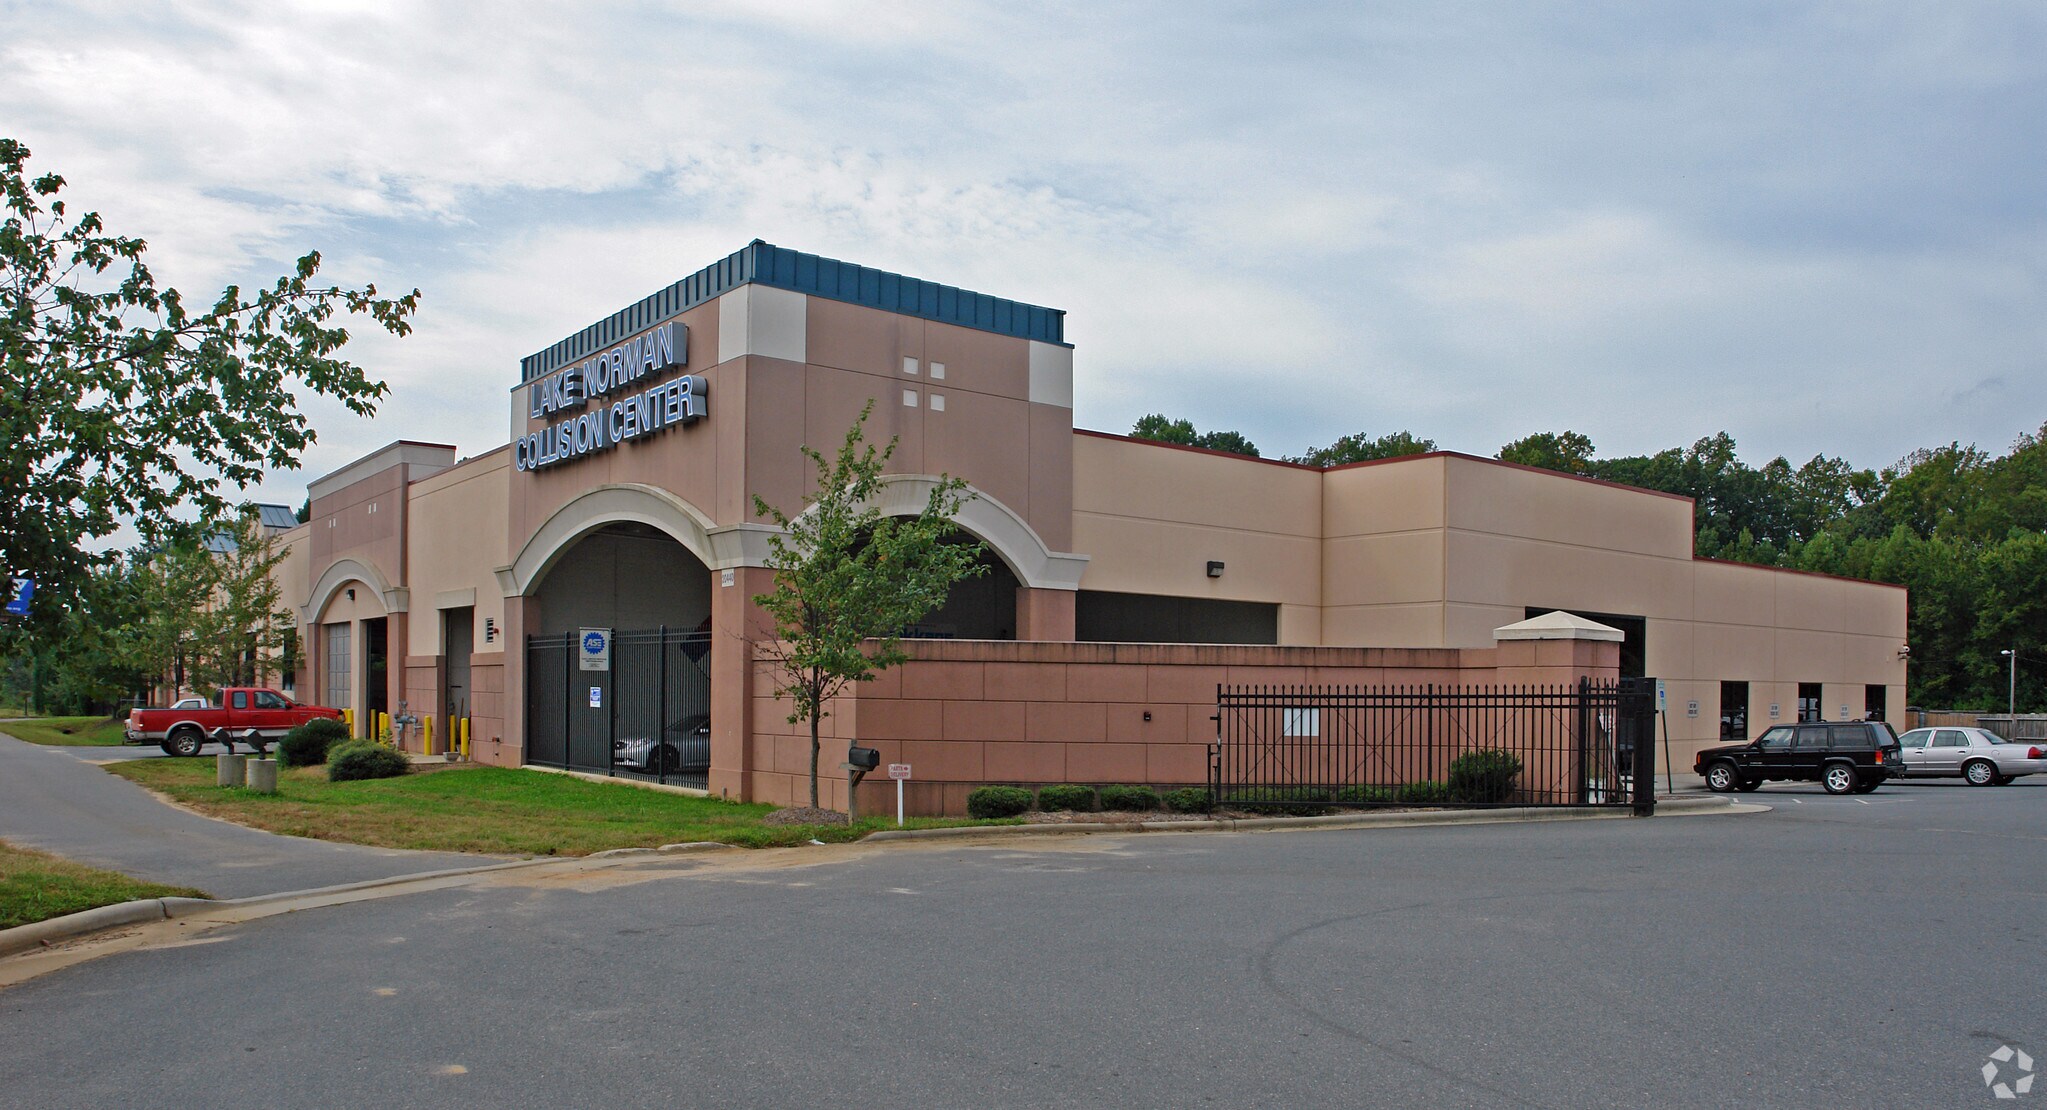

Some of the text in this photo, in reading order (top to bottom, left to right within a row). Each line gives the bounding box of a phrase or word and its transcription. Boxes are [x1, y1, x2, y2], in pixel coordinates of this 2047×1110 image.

[531, 321, 674, 419] LAKE NORMAN
[515, 374, 694, 472] COLLISION CENTER
[586, 638, 602, 647] ASE
